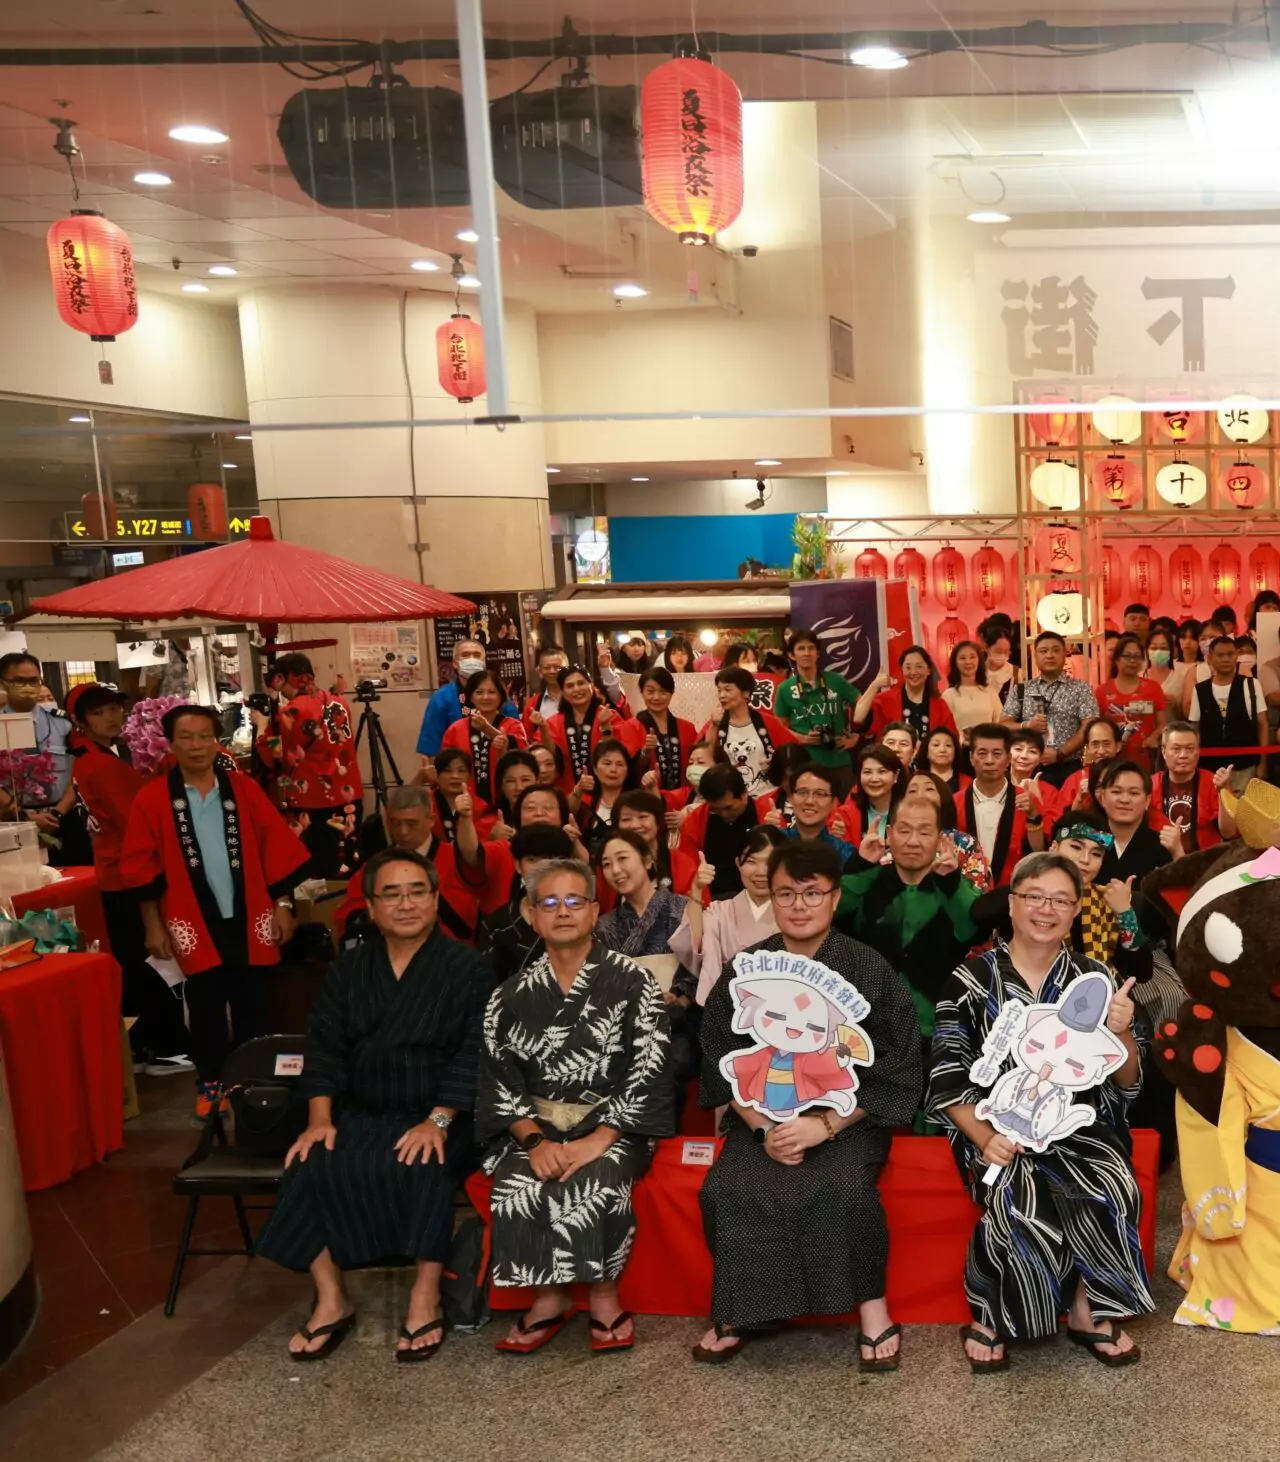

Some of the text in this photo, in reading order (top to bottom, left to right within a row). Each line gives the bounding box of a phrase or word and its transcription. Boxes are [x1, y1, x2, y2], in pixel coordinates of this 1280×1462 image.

[450, 333, 468, 381] 台北地下街
[227, 814, 240, 869] 台北地下街
[739, 955, 867, 1019] 台北市政府產發局
[976, 1004, 1023, 1083] 台北地下街
